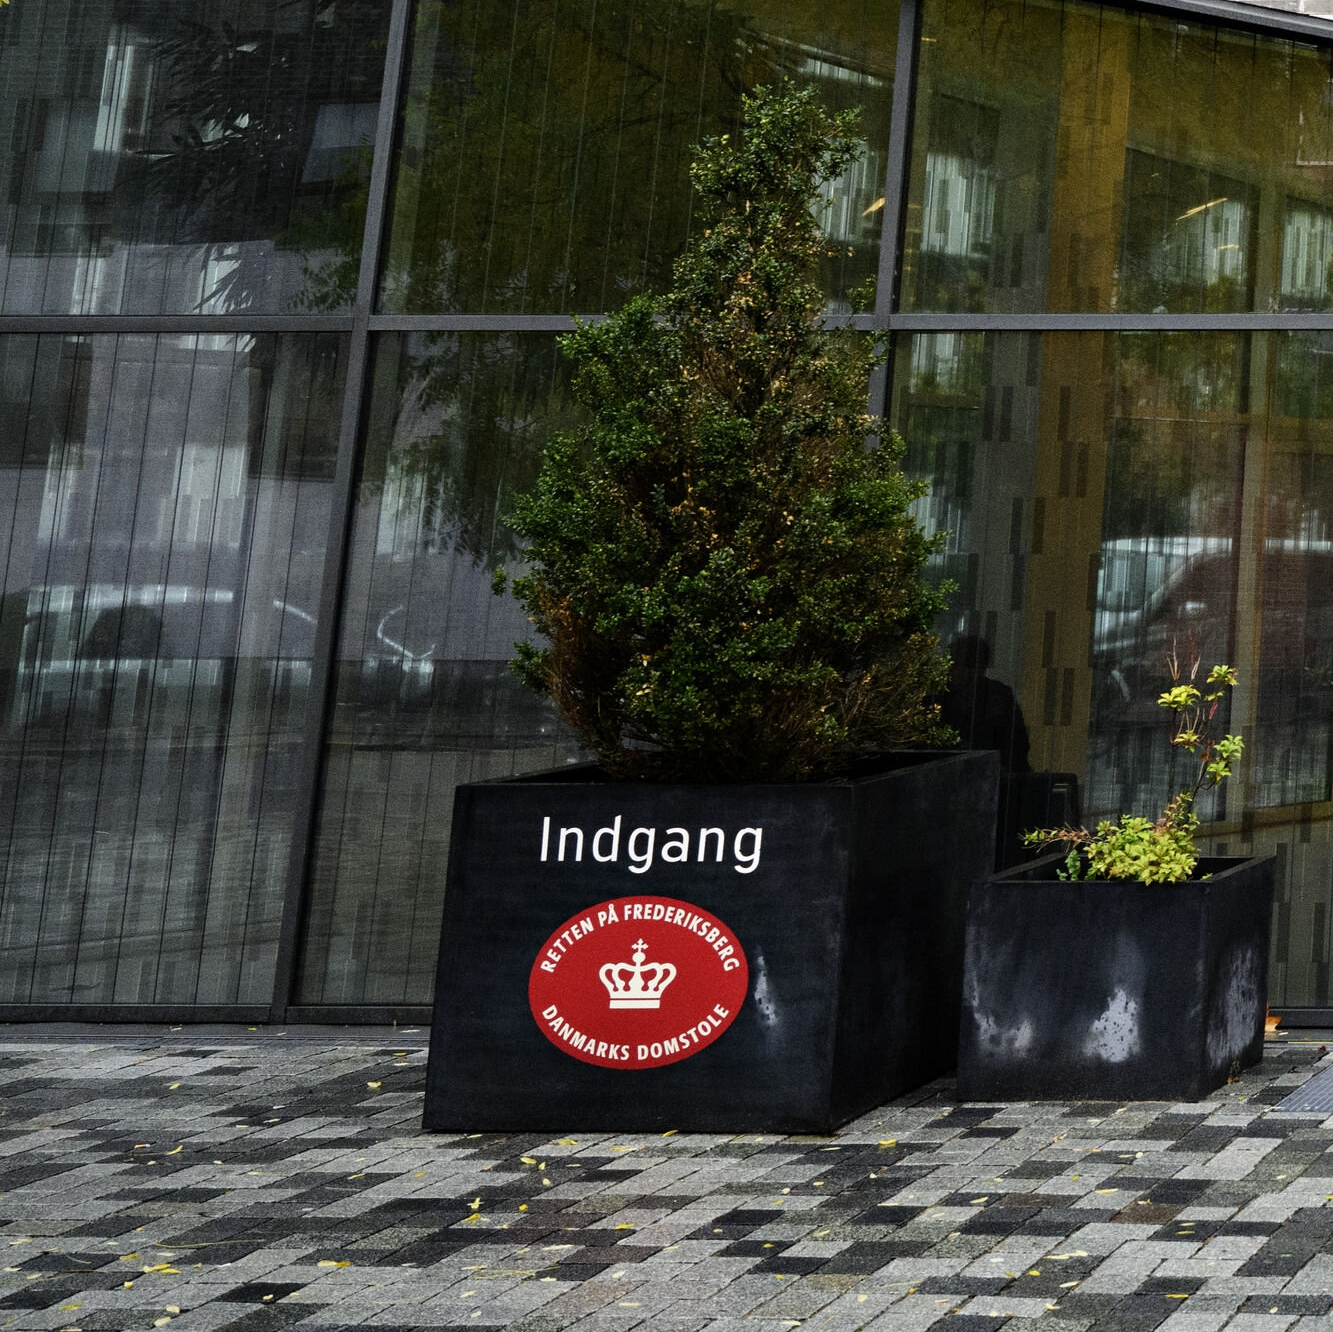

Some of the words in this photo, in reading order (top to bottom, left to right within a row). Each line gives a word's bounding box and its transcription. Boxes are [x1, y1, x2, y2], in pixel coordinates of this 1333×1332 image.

[541, 815, 762, 873] Indgang
[540, 918, 595, 973] RETTEN
[597, 903, 619, 928] PÅ
[624, 903, 740, 973] FREDERIKSBERG
[542, 1004, 630, 1061] DANMARKS
[637, 1003, 729, 1061] DOMSTOLE
